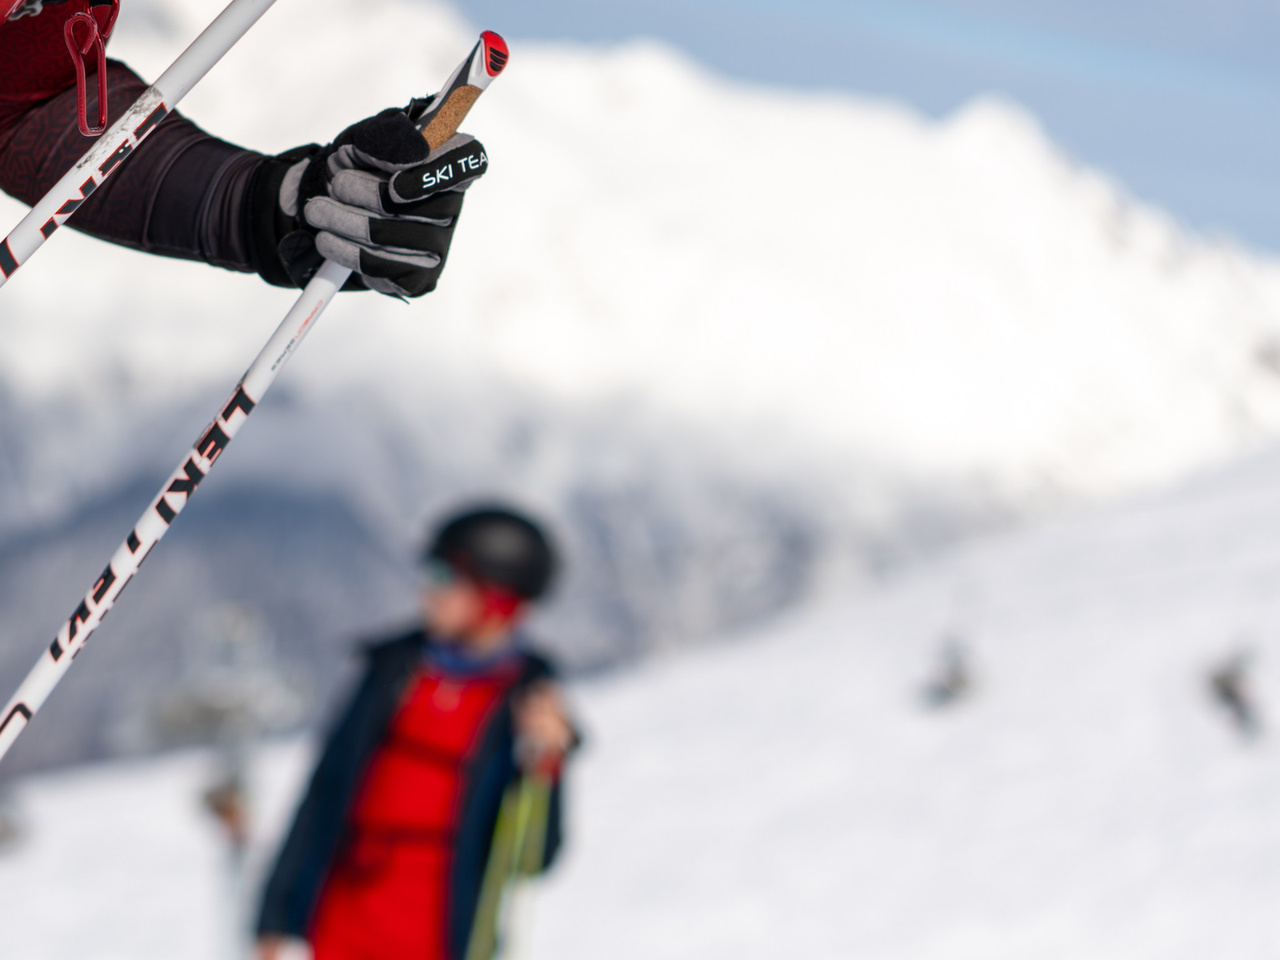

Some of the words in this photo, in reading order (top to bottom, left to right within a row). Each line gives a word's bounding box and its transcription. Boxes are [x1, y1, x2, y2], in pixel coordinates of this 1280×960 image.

[422, 163, 453, 189] SKI
[457, 151, 488, 173] TEA
[156, 383, 257, 525] LEKI
